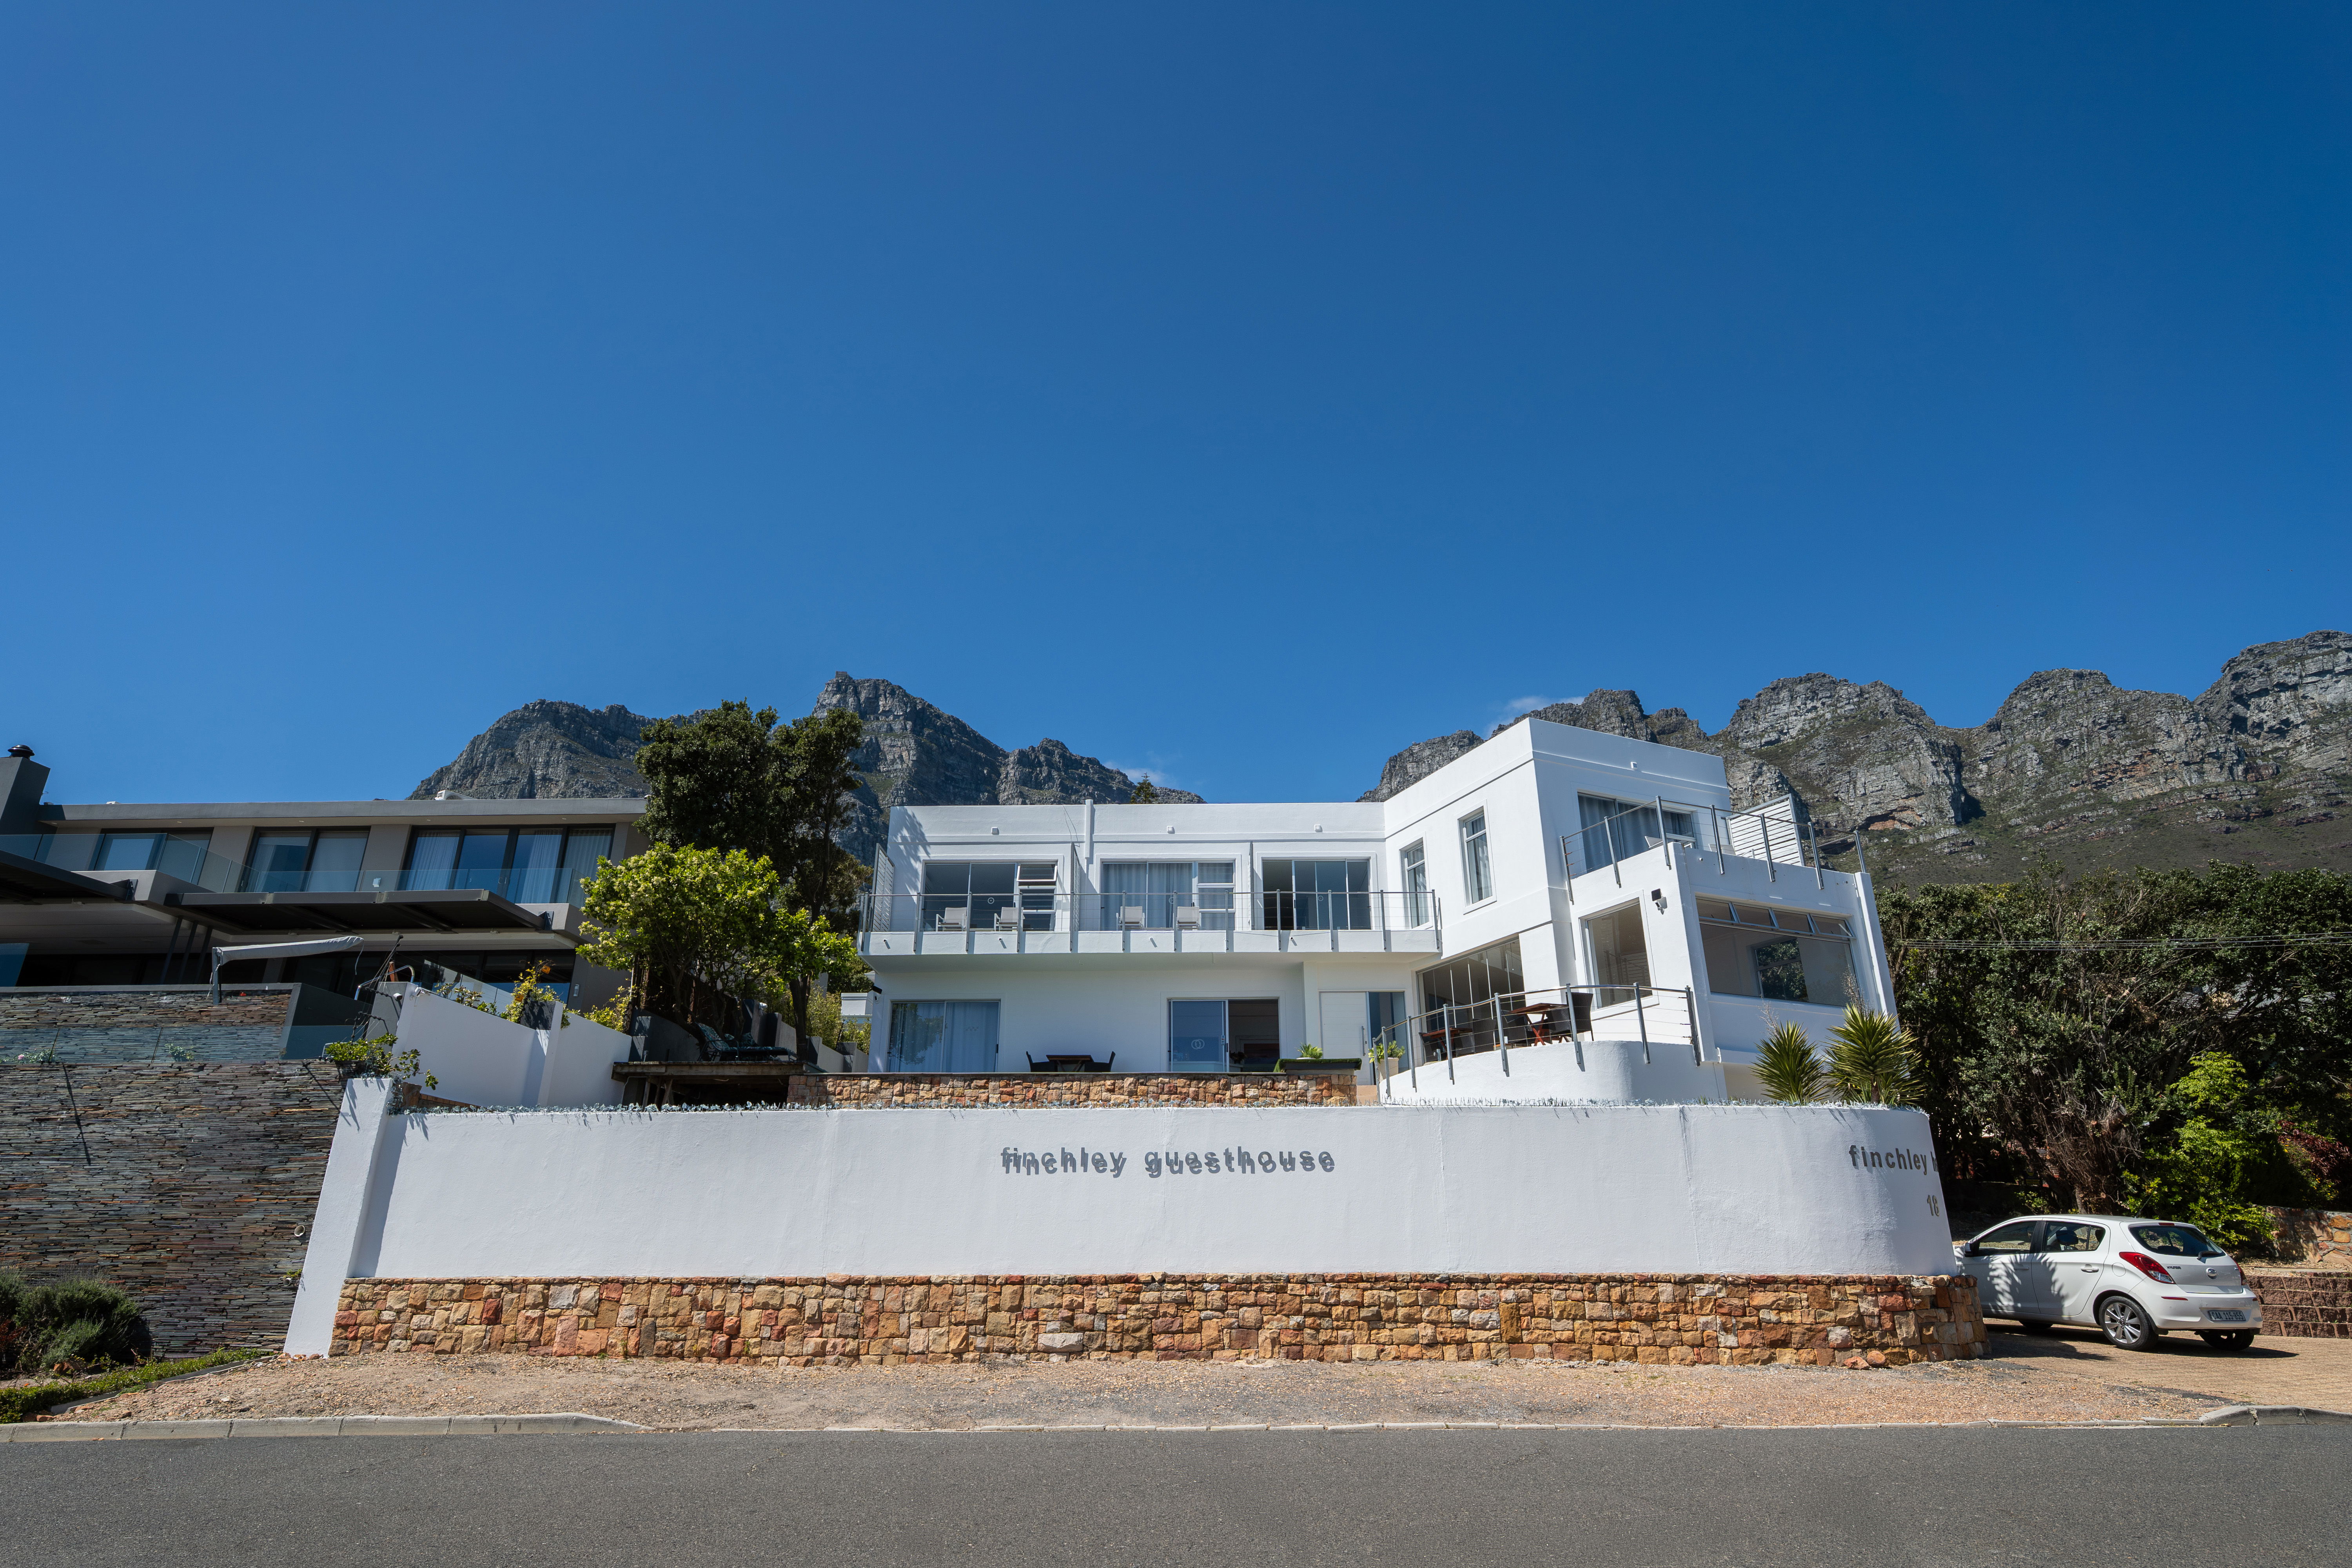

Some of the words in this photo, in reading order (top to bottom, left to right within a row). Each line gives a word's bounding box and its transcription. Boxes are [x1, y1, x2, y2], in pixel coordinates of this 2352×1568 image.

[1000, 1147, 1124, 1174] finchley
[1144, 1146, 1333, 1175] guesthouse
[1849, 1145, 1927, 1175] finchley
[1927, 1194, 1940, 1217] 18
[2212, 1312, 2223, 1320] CAA
[2223, 1312, 2244, 1320] 115-855
